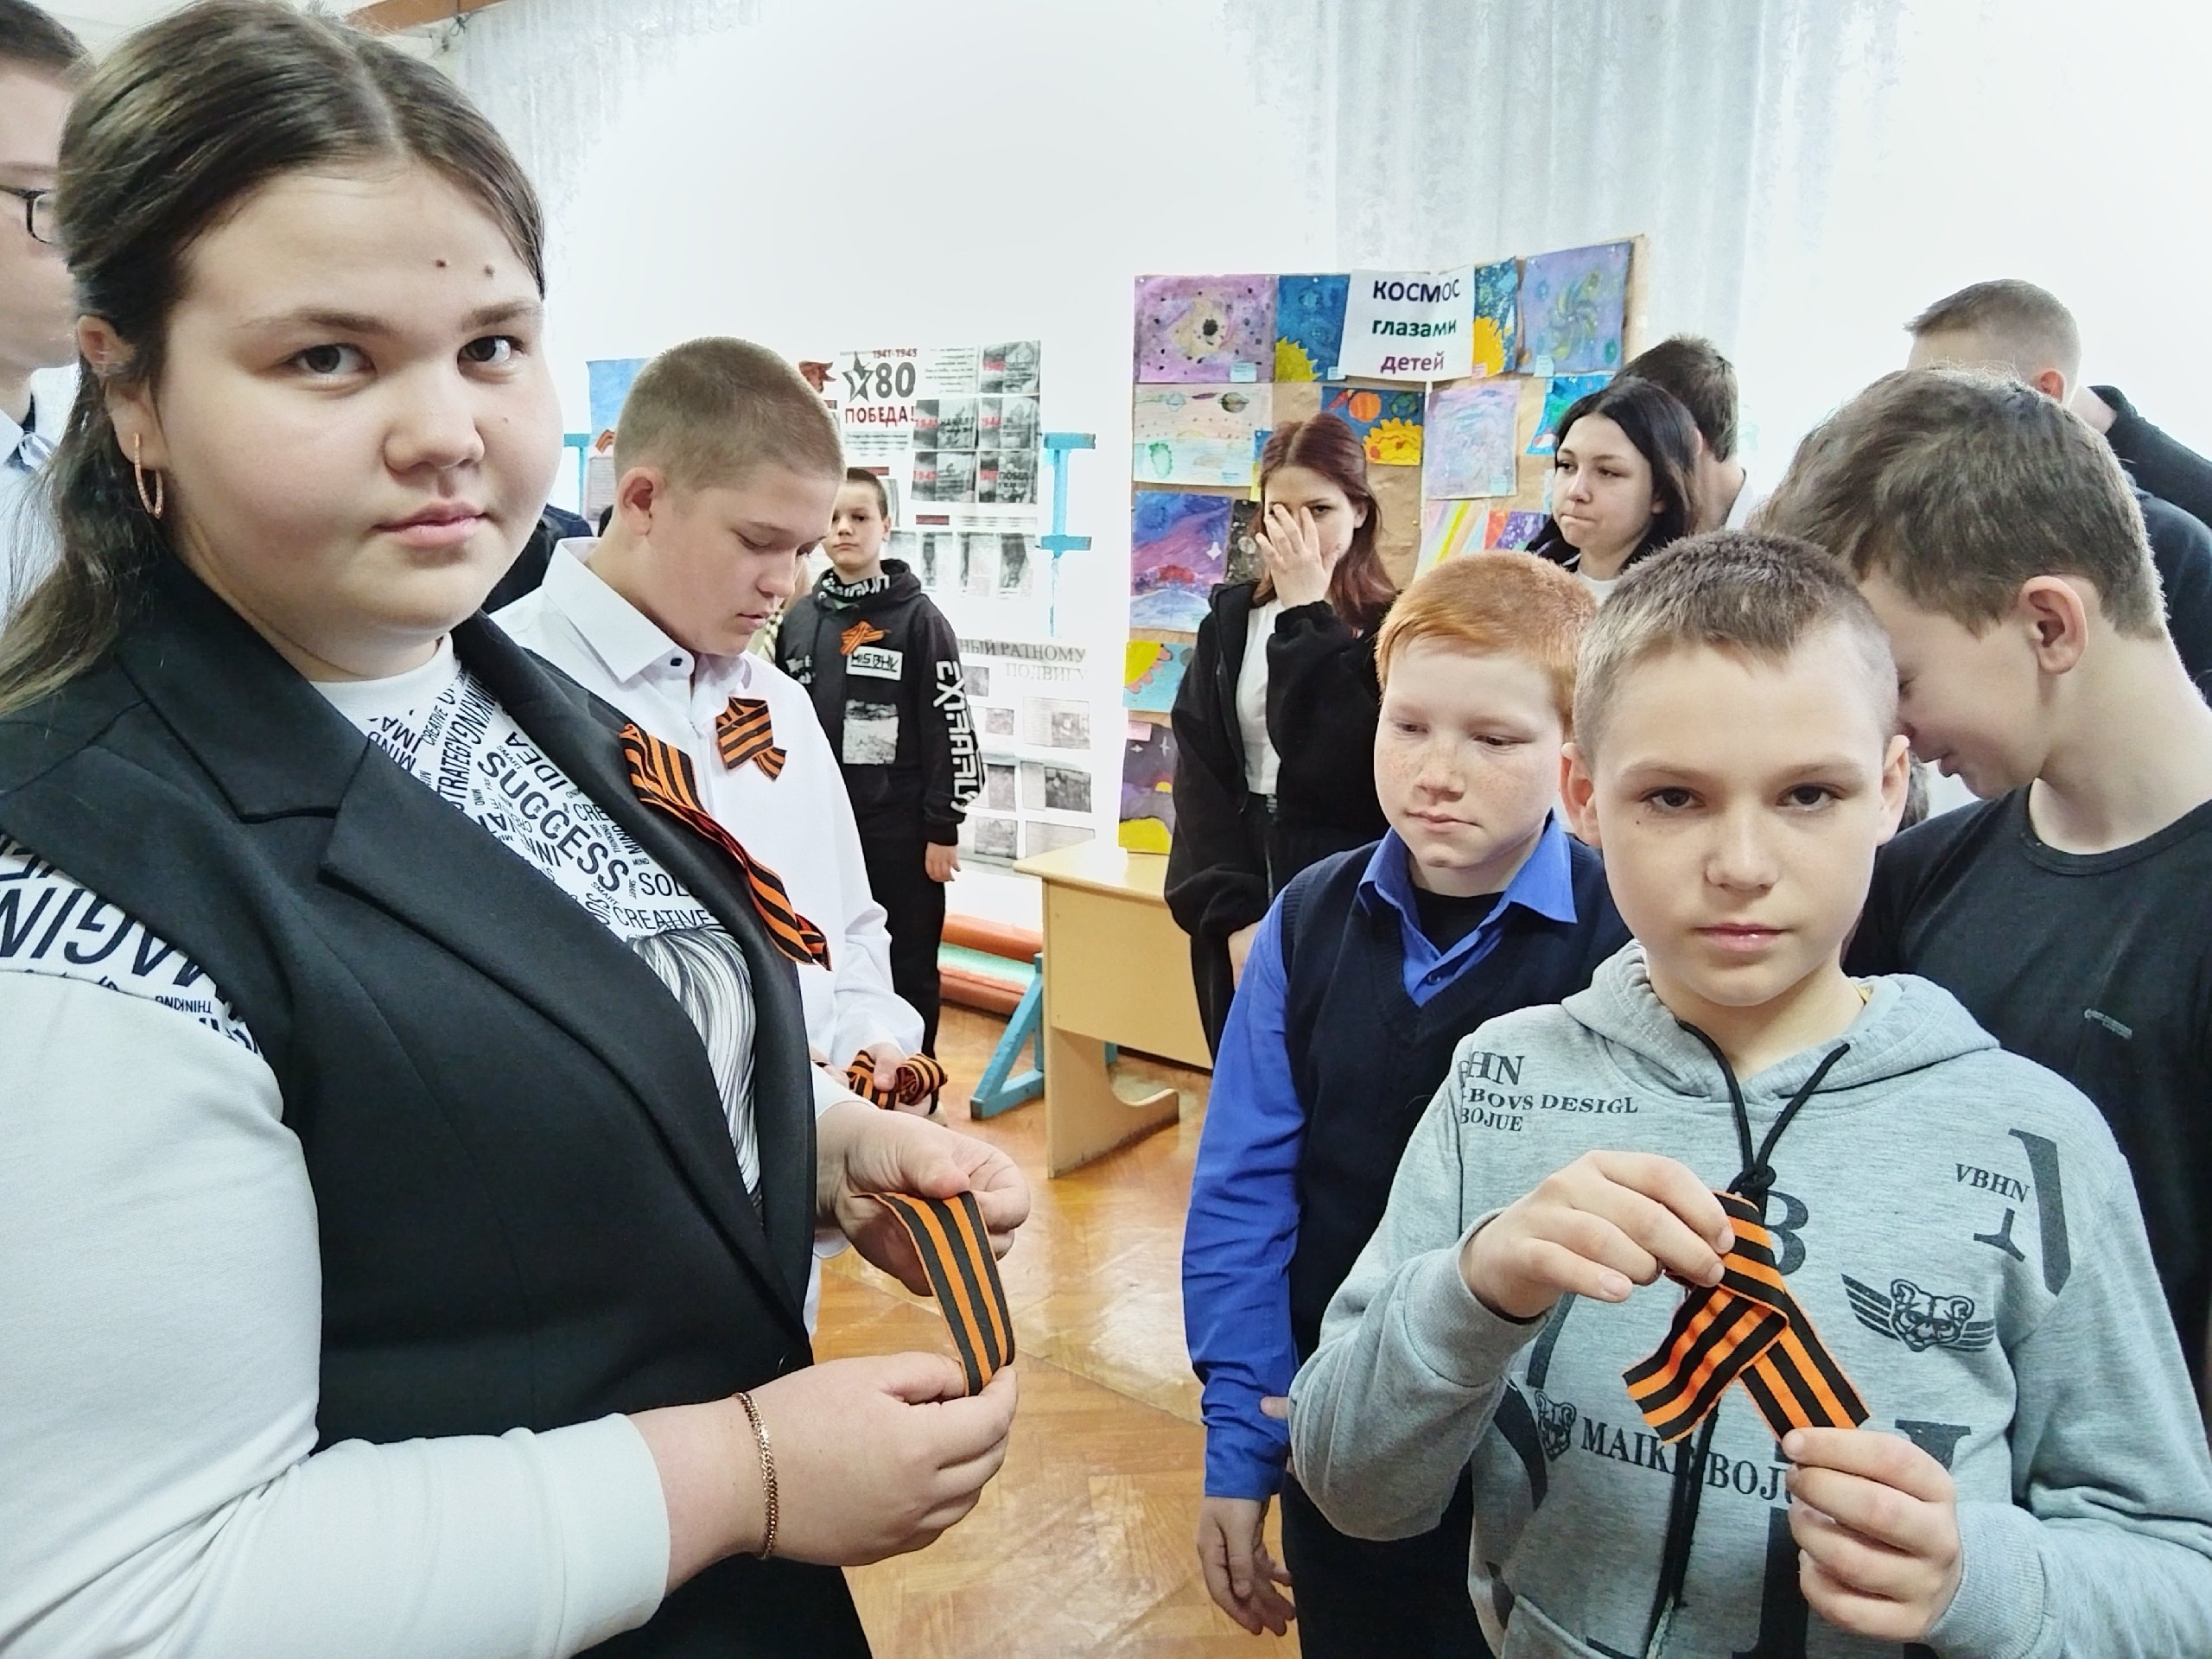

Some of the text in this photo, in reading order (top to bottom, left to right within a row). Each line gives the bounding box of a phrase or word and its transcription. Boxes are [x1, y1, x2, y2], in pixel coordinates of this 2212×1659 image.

[1372, 278, 1460, 302] КОСМОС
[1371, 319, 1457, 338] глазами
[1380, 350, 1444, 374] детей
[875, 361, 916, 399] 80
[845, 405, 915, 428] ПОБЕДА!
[1000, 642, 1086, 663] РАТНОМУ
[505, 731, 568, 791] IDEA
[476, 751, 629, 892] SUCCESS
[613, 906, 709, 931] CREATIVE
[1955, 1163, 2030, 1203] VBHN
[1705, 1452, 1793, 1504] BOJ
